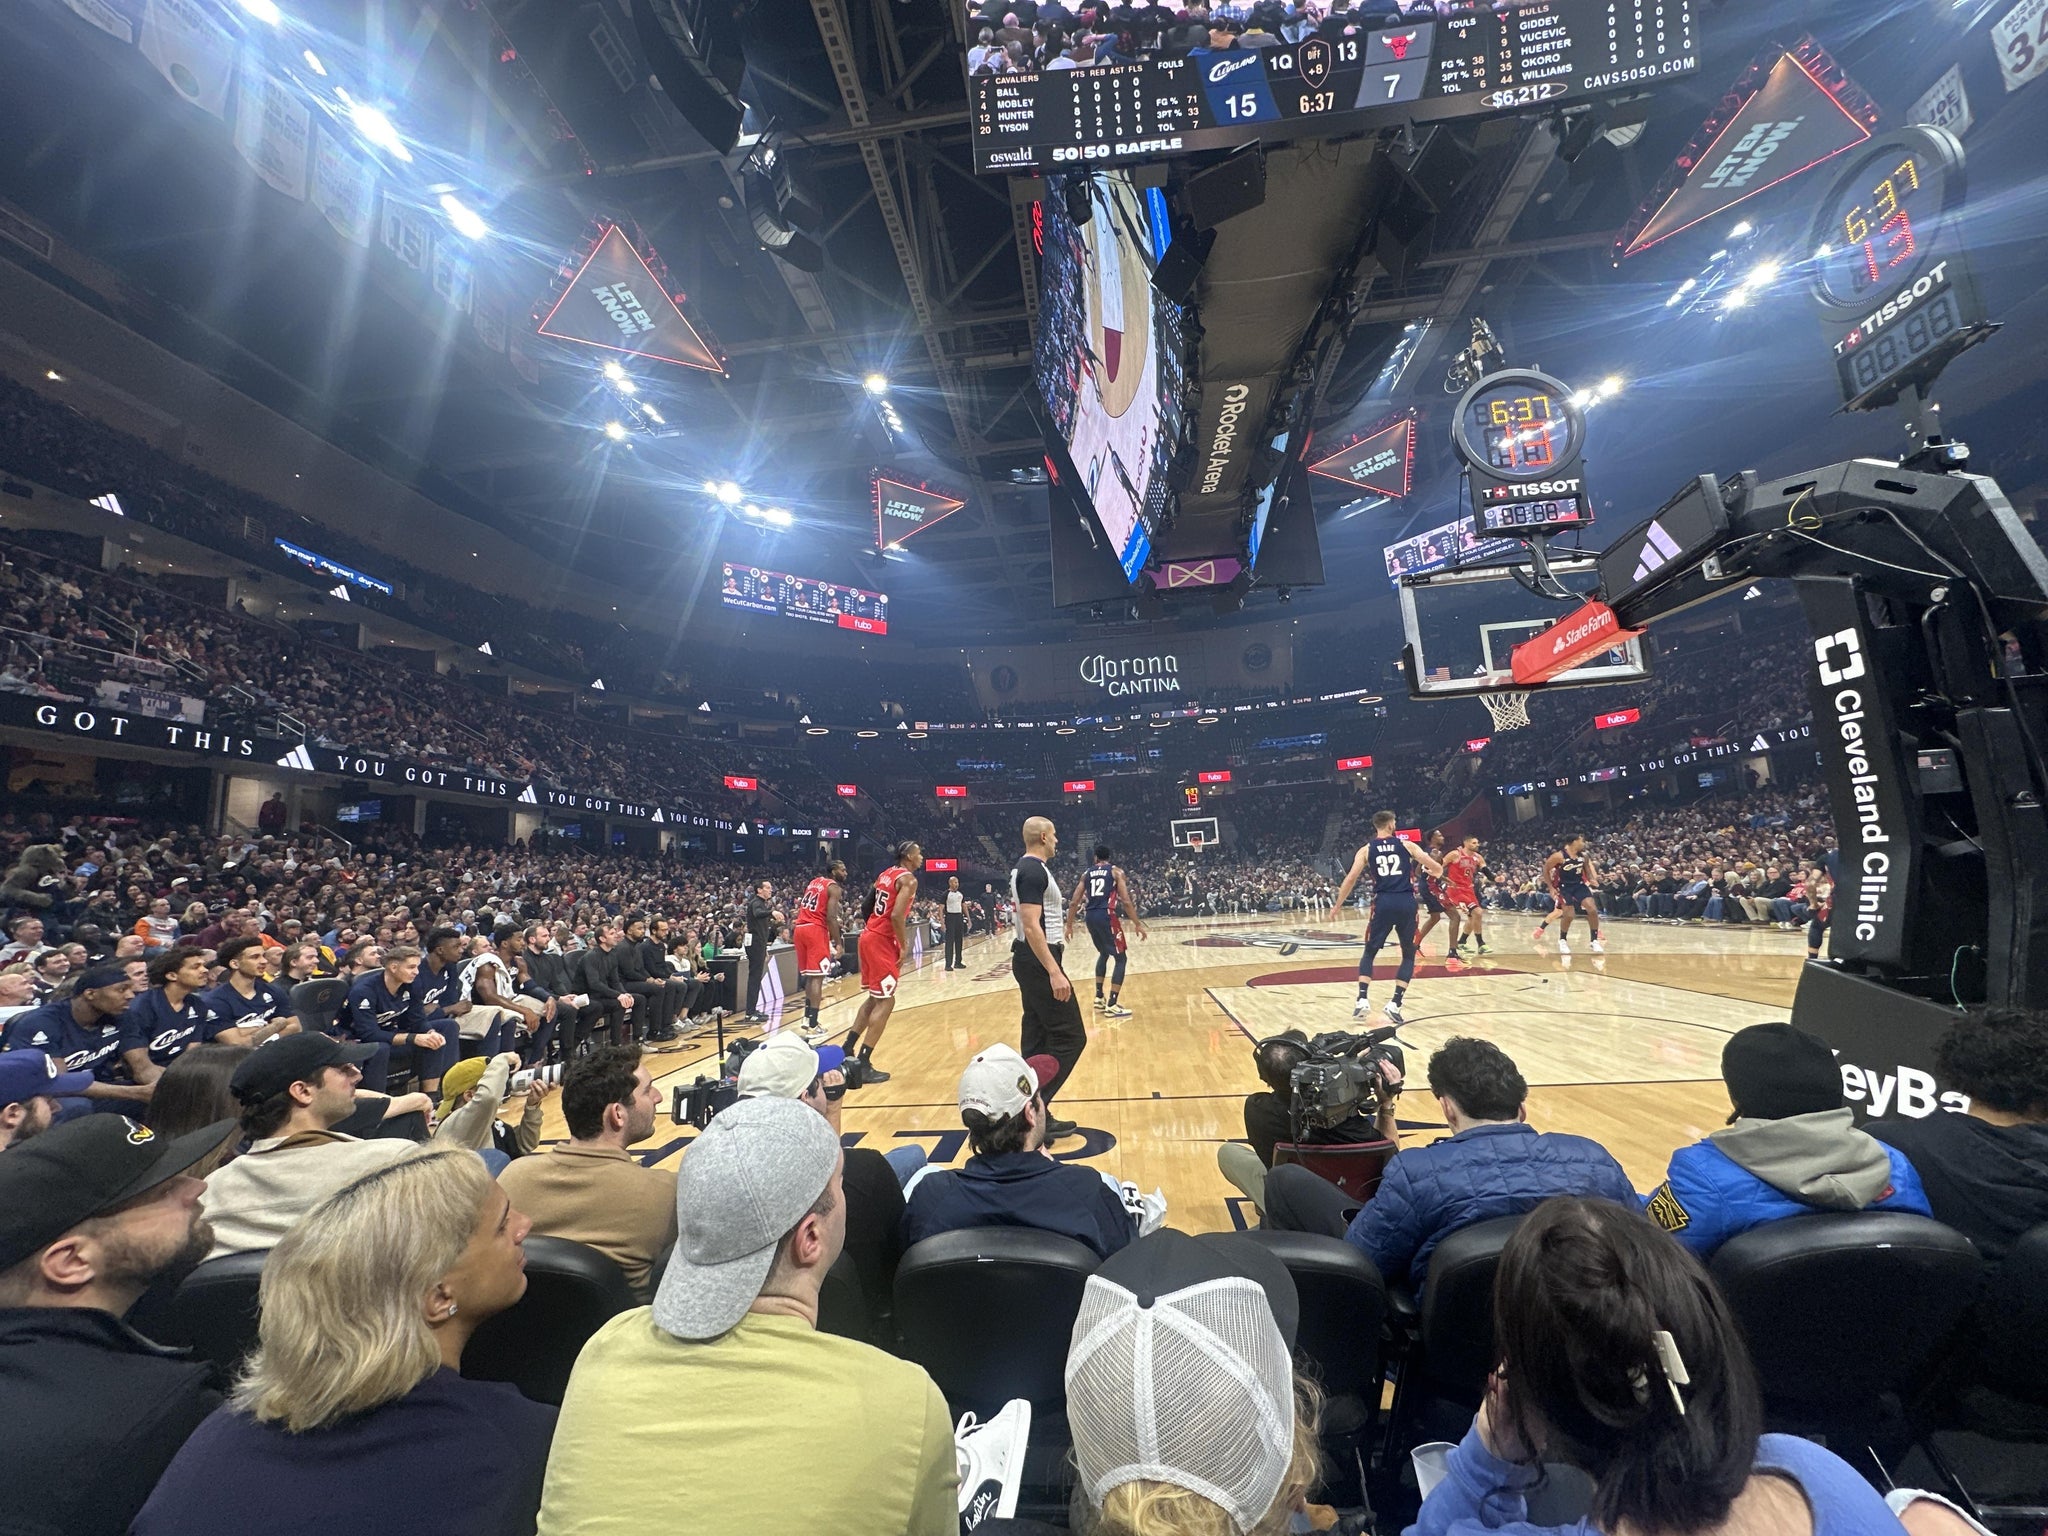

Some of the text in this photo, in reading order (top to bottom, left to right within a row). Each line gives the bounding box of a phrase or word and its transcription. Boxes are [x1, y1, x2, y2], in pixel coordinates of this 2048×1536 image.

[1519, 5, 1549, 17] BULLS
[1448, 17, 1476, 39] FOULS 4
[1500, 15, 1560, 34] 3 GIDDEY
[1501, 27, 1566, 46] 9 VUCEVIC
[1308, 50, 1321, 60] DIFF
[1338, 42, 1357, 62] 13
[1500, 38, 1572, 59] 13 HUERTER
[1158, 60, 1184, 79] FOULS 1
[1270, 54, 1293, 70] 1Q
[1308, 64, 1323, 75] +8
[1441, 56, 1484, 70] FG % 38
[1500, 54, 1560, 72] 35 OKORO
[996, 75, 1039, 84] CAVALIERS
[1110, 67, 1124, 75] AST
[1129, 65, 1143, 73] FLS
[1442, 69, 1485, 82] 3PT % 50
[1500, 64, 1573, 84] 44 WILLIAMS
[1584, 56, 1695, 89] CAVS5050.COM
[996, 88, 1019, 97] BALL
[1072, 83, 1079, 92] 0
[1094, 82, 1100, 90] 0
[1113, 80, 1119, 88] 0
[1133, 78, 1139, 86] 0
[1384, 74, 1400, 99] 7
[1442, 80, 1486, 94] TOL 6
[981, 90, 1140, 111] 4 MOBLEY 4 0 1 0
[1156, 95, 1197, 106] FG % 71
[1225, 94, 1257, 118] 15
[1300, 92, 1334, 114] 6:37
[1492, 84, 1552, 109] $6,212
[980, 114, 990, 123] 12
[998, 111, 1034, 121] HUNTER
[1074, 107, 1080, 116] 8
[1114, 103, 1121, 112] 0
[1134, 102, 1141, 110] 0
[1157, 107, 1199, 119] 3PT % 33
[980, 126, 991, 135] 20
[999, 123, 1029, 133] TYSON
[1075, 119, 1081, 128] 2
[1096, 117, 1102, 126] 2
[1116, 116, 1120, 124] 1
[1076, 125, 1142, 139] 0 0 0 0
[1158, 121, 1198, 132] TOL 7
[990, 147, 1032, 163] oswald
[1115, 138, 1182, 155] RAFFLE
[1700, 123, 1774, 188] LET EM
[1723, 116, 1805, 188] KNOW.
[1845, 159, 1918, 245] 6:37
[1864, 209, 1916, 282] 13
[611, 282, 656, 332] LET EM
[1861, 261, 1947, 335] TISSOT
[591, 286, 640, 338] KNOW.
[1491, 396, 1550, 424] 6:37
[1201, 402, 1246, 493] Rocket Arena
[1504, 422, 1554, 468] 13
[1349, 449, 1394, 473] LET EM
[1352, 456, 1400, 480] KNOW.
[1508, 479, 1579, 496] TISSOT
[884, 508, 922, 522] KNOW.
[887, 500, 925, 514] LET EM
[723, 596, 776, 612] WeCutCarbon.com
[854, 619, 872, 630] fubo
[1080, 654, 1178, 686] Corona
[1108, 677, 1180, 696] CANTINA
[1607, 713, 1627, 723] fubo
[36, 705, 253, 756] GOT THIS
[1778, 726, 1810, 742] YOU
[1640, 742, 1740, 772] YOU GOT THIS
[337, 756, 507, 795] YOU GOT THIS
[1522, 783, 1533, 791] 15
[1556, 778, 1569, 786] 6:37
[1591, 773, 1597, 781] 7
[549, 792, 646, 817] YOU GOT THIS
[670, 812, 733, 830] YOU GOT THIS
[1834, 690, 1890, 942] Cleveland Clinic
[1376, 854, 1402, 876] 32
[1090, 878, 1105, 896] 12
[801, 891, 820, 912] 44
